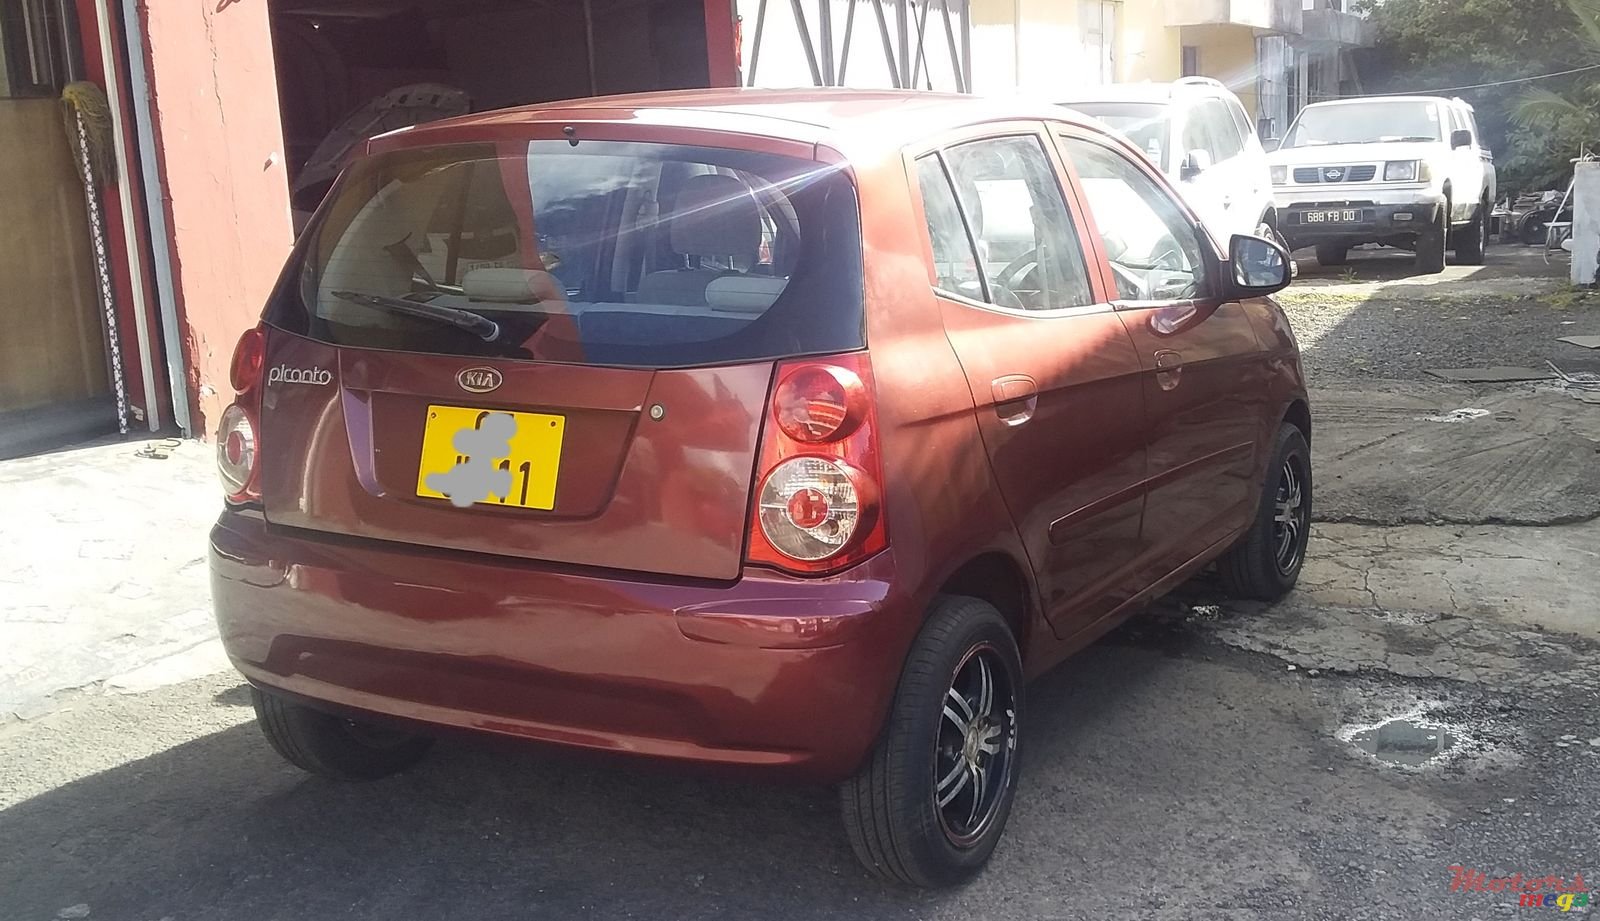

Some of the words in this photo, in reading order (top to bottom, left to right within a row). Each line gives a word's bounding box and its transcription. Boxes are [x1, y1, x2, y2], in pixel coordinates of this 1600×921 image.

[1307, 212, 1325, 223] 688
[1327, 211, 1340, 222] FB
[268, 363, 332, 387] picanto
[465, 371, 494, 388] KIA
